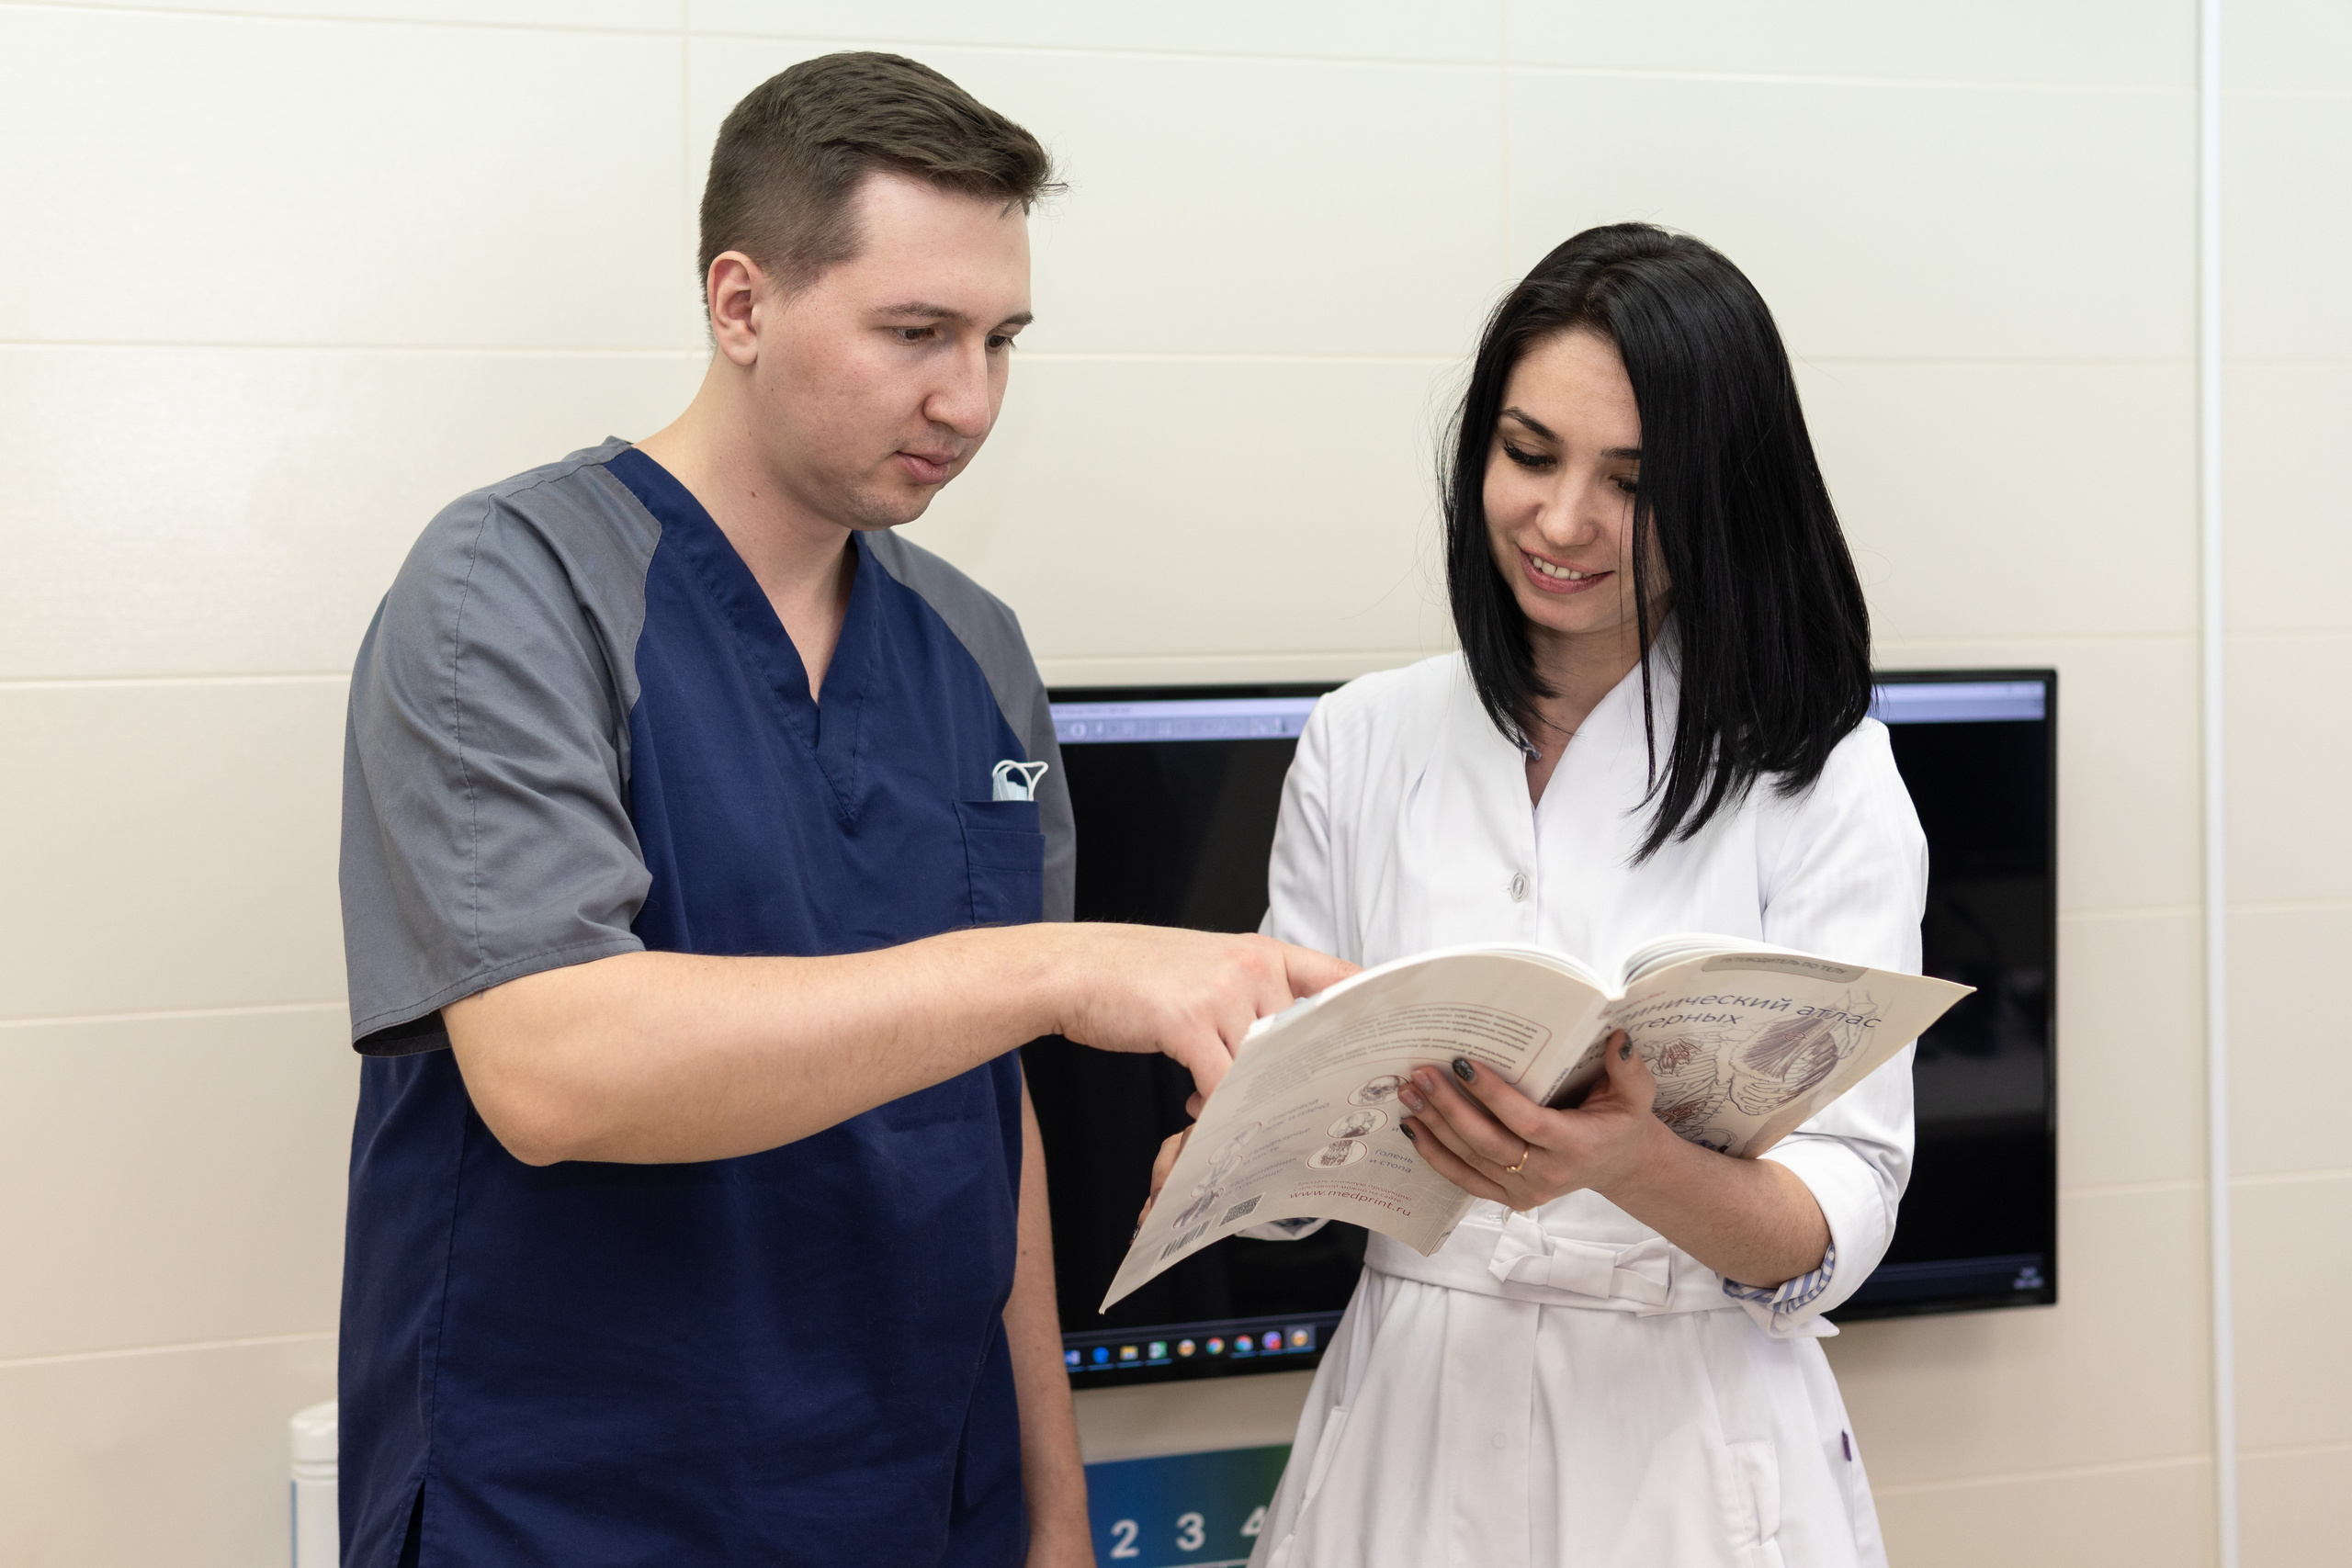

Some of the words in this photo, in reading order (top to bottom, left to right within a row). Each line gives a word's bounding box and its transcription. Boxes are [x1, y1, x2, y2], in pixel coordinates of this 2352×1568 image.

[1802, 961, 1819, 969] ПО
[1820, 964, 1849, 975] ТЕЛУ
[1796, 1005, 1882, 1028] атлас
[1374, 1148, 1414, 1164] Голень
[1379, 1159, 1412, 1174] стопа
[1340, 1185, 1368, 1193] можно
[1379, 1193, 1403, 1203] сайте
[1368, 1184, 1412, 1201] продукцию
[1290, 1190, 1412, 1217] www.medprint.ru
[1110, 1518, 1139, 1559] 2
[1176, 1512, 1205, 1551] 3
